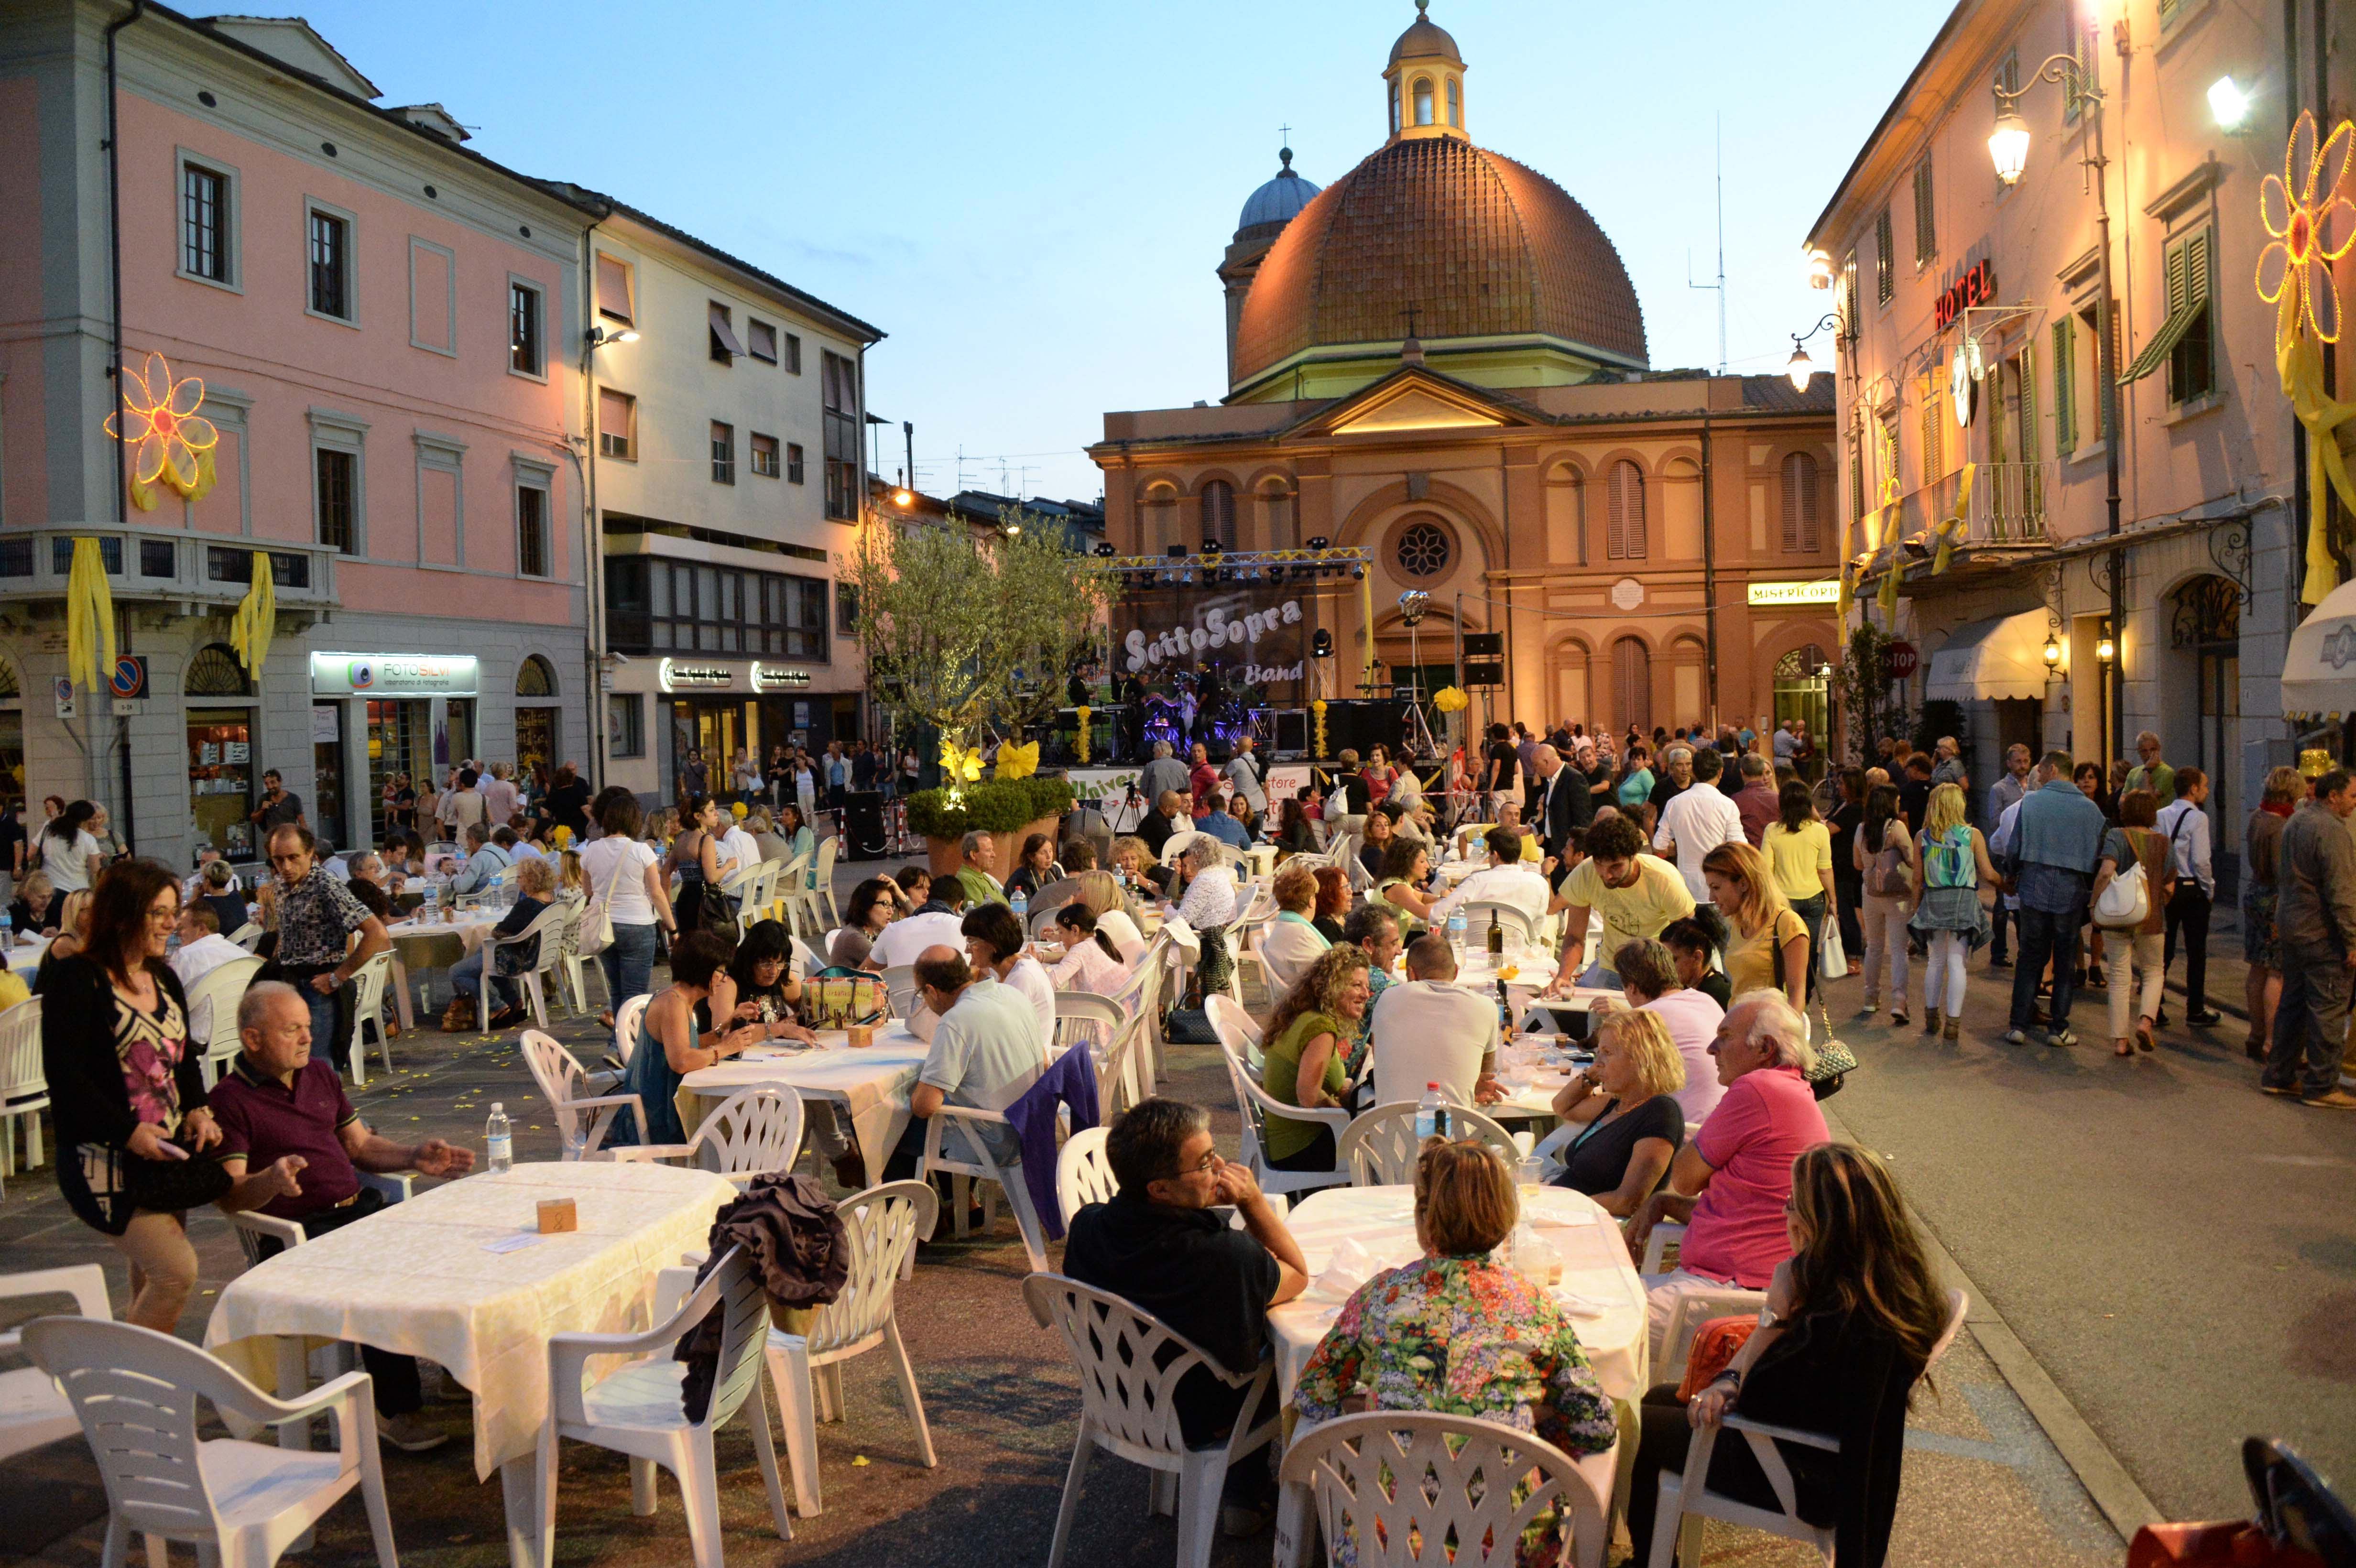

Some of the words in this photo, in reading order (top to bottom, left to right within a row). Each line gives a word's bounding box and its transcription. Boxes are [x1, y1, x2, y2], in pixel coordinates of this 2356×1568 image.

[1935, 260, 1991, 330] HOTEL
[1754, 588, 1841, 599] MISERICORD
[1886, 653, 1916, 667] STOP
[1244, 660, 1303, 685] Band
